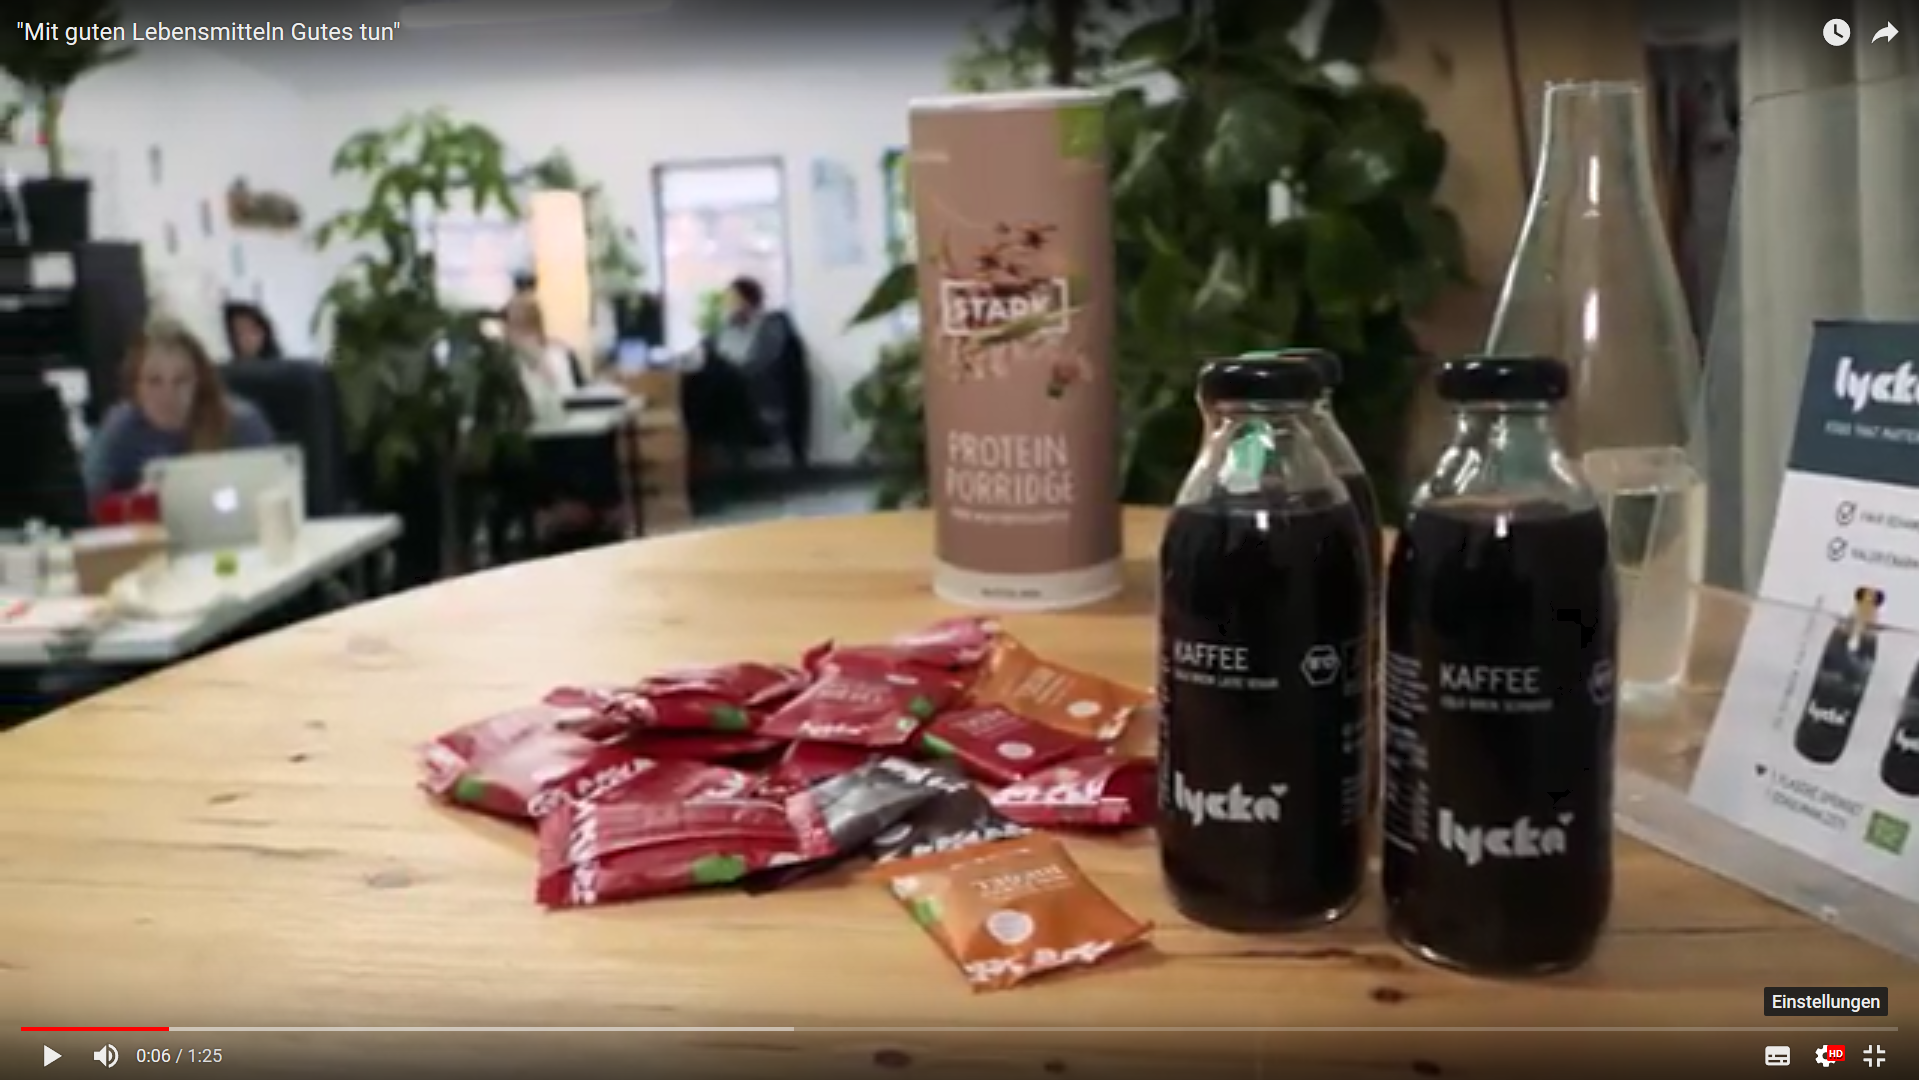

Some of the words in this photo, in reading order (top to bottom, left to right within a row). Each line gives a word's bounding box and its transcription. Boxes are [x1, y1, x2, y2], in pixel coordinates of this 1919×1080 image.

[1835, 356, 1919, 412] lyck
[947, 430, 1068, 468] PROTEIN
[946, 467, 1075, 504] PORRIDGE
[1174, 640, 1249, 671] KAFFEE
[1439, 663, 1540, 693] KAFFEE
[1174, 770, 1281, 827] lycka
[1438, 808, 1568, 866] lycka
